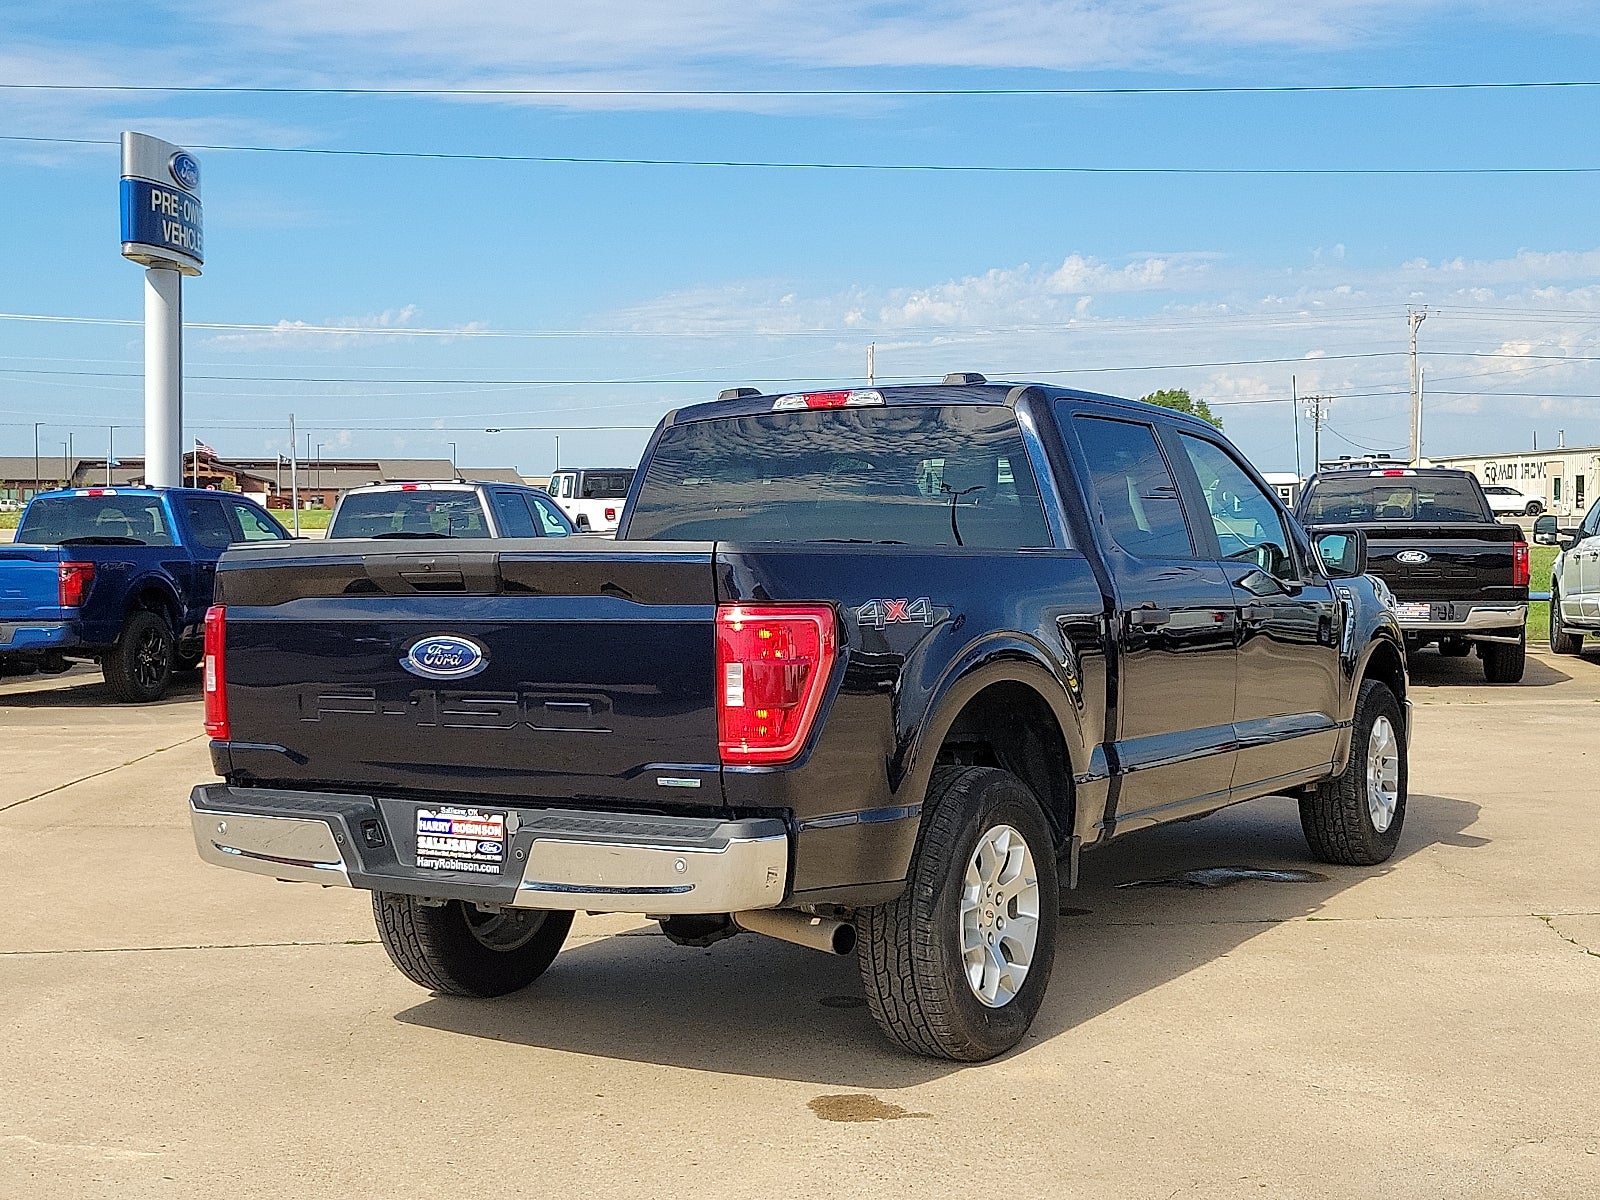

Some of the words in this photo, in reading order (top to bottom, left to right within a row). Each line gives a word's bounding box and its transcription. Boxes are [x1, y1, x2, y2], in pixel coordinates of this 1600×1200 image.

[423, 643, 463, 667] Ford
[299, 686, 614, 734] F-150
[419, 820, 451, 833] HARRY
[452, 822, 502, 837] ROBINSON
[417, 836, 478, 853] SALLISAW
[417, 857, 499, 873] HarryRobinson.com
